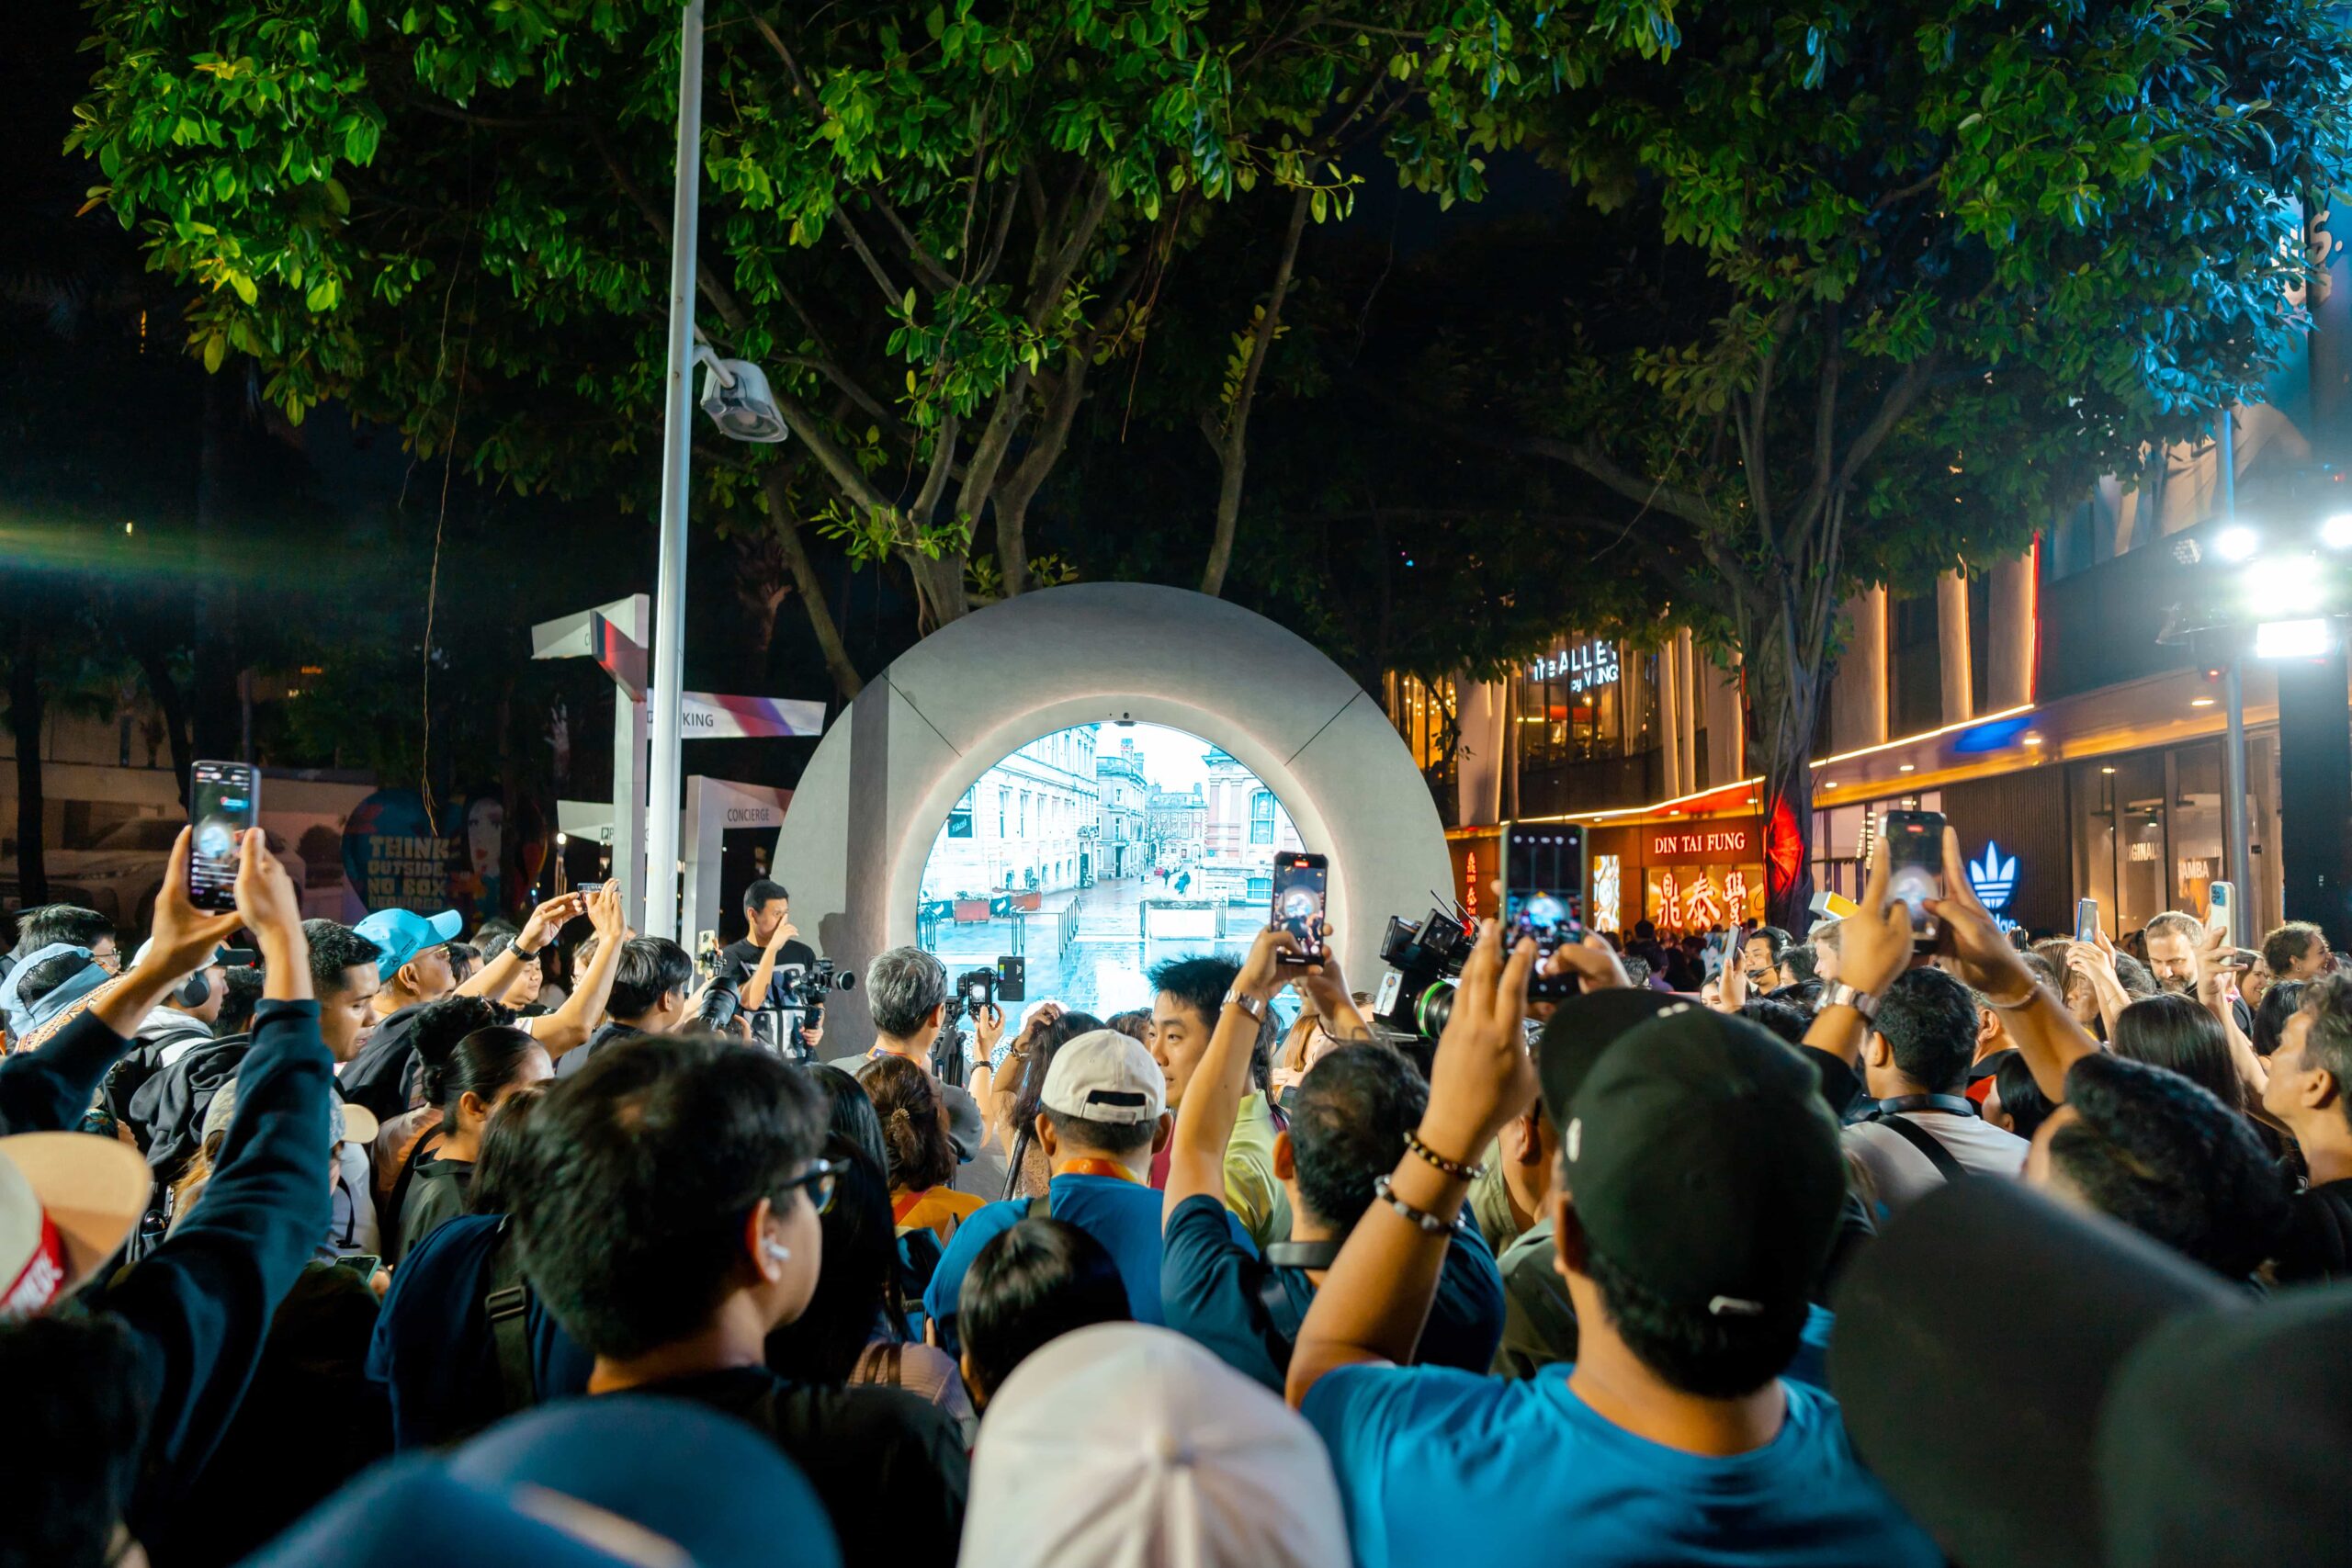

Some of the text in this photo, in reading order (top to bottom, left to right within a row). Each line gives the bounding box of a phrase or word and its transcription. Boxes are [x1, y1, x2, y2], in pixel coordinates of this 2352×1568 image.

[683, 713, 714, 727] KING
[727, 808, 770, 822] CONCIERGE
[368, 837, 450, 859] THINK
[1655, 832, 1746, 853] DIN TAI FUNG
